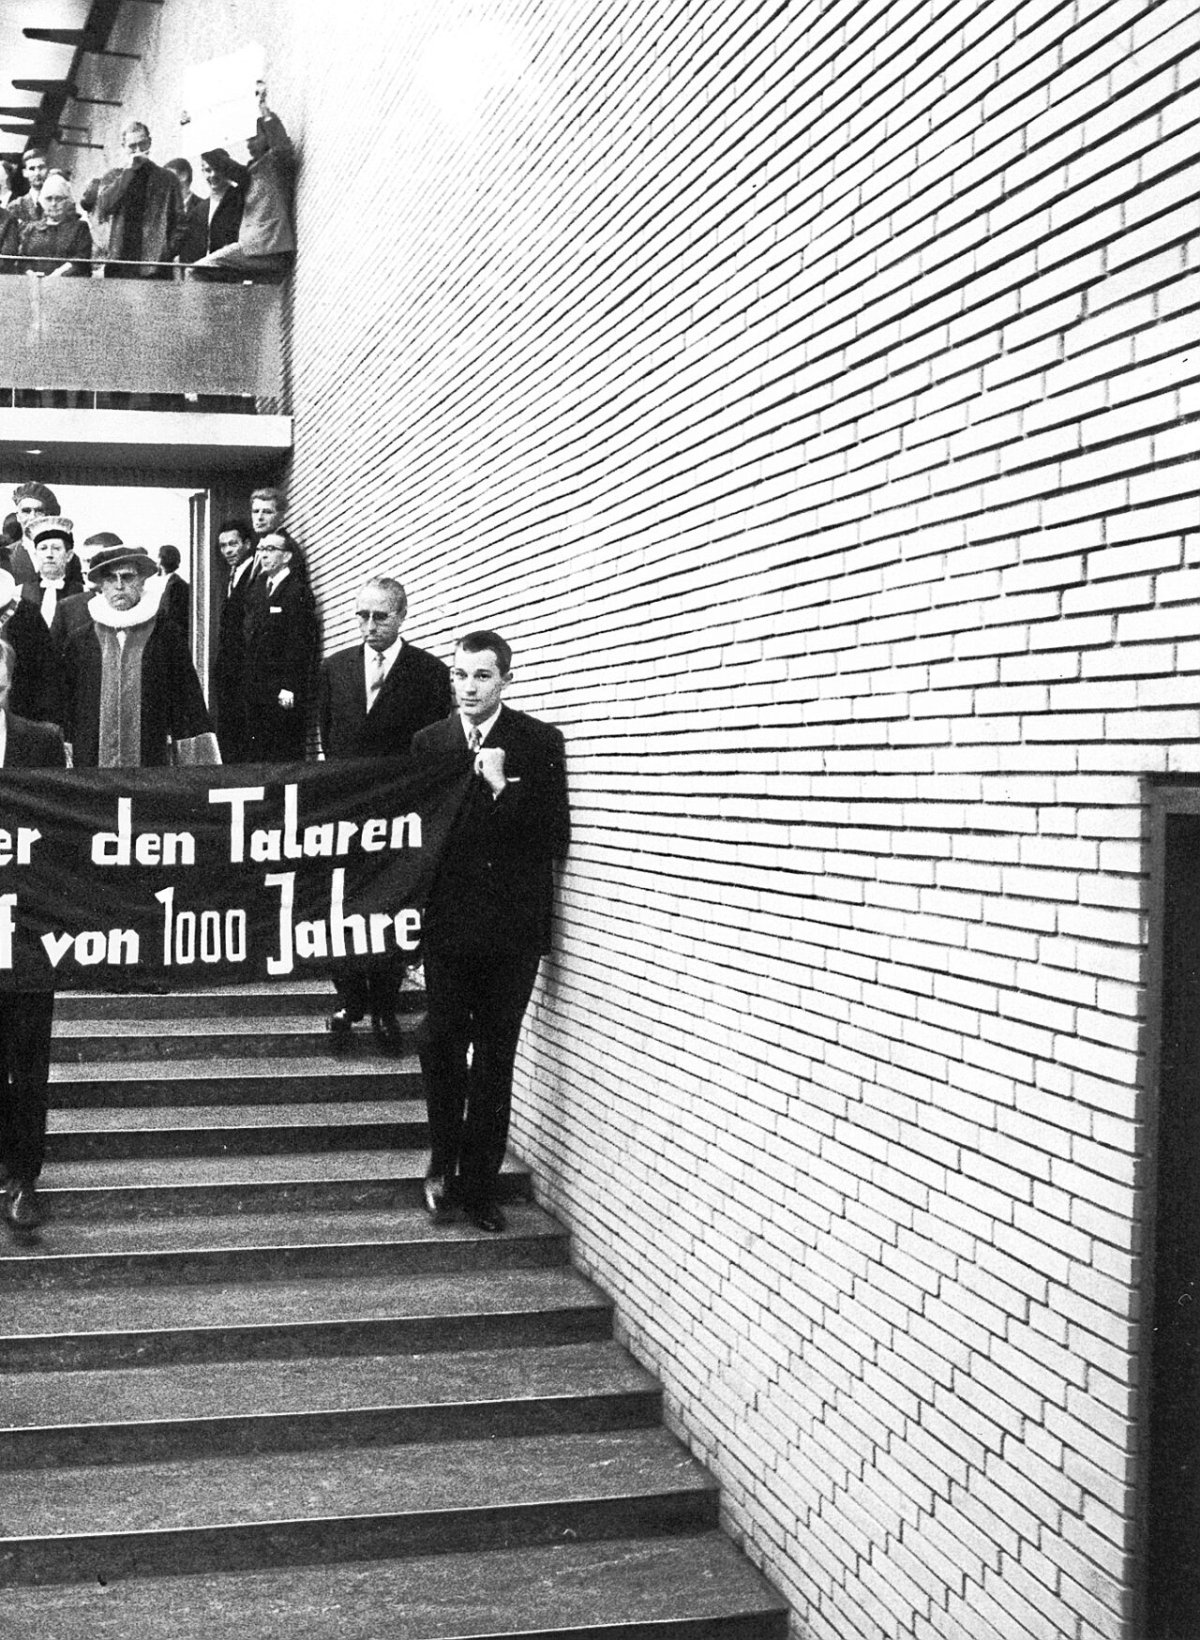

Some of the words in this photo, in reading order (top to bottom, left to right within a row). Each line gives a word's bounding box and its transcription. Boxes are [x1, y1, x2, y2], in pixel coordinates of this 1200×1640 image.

[90, 797, 196, 866] den
[208, 783, 423, 863] Talaren
[40, 928, 140, 968] von
[154, 886, 247, 966] 1000
[264, 867, 426, 976] Jahre
